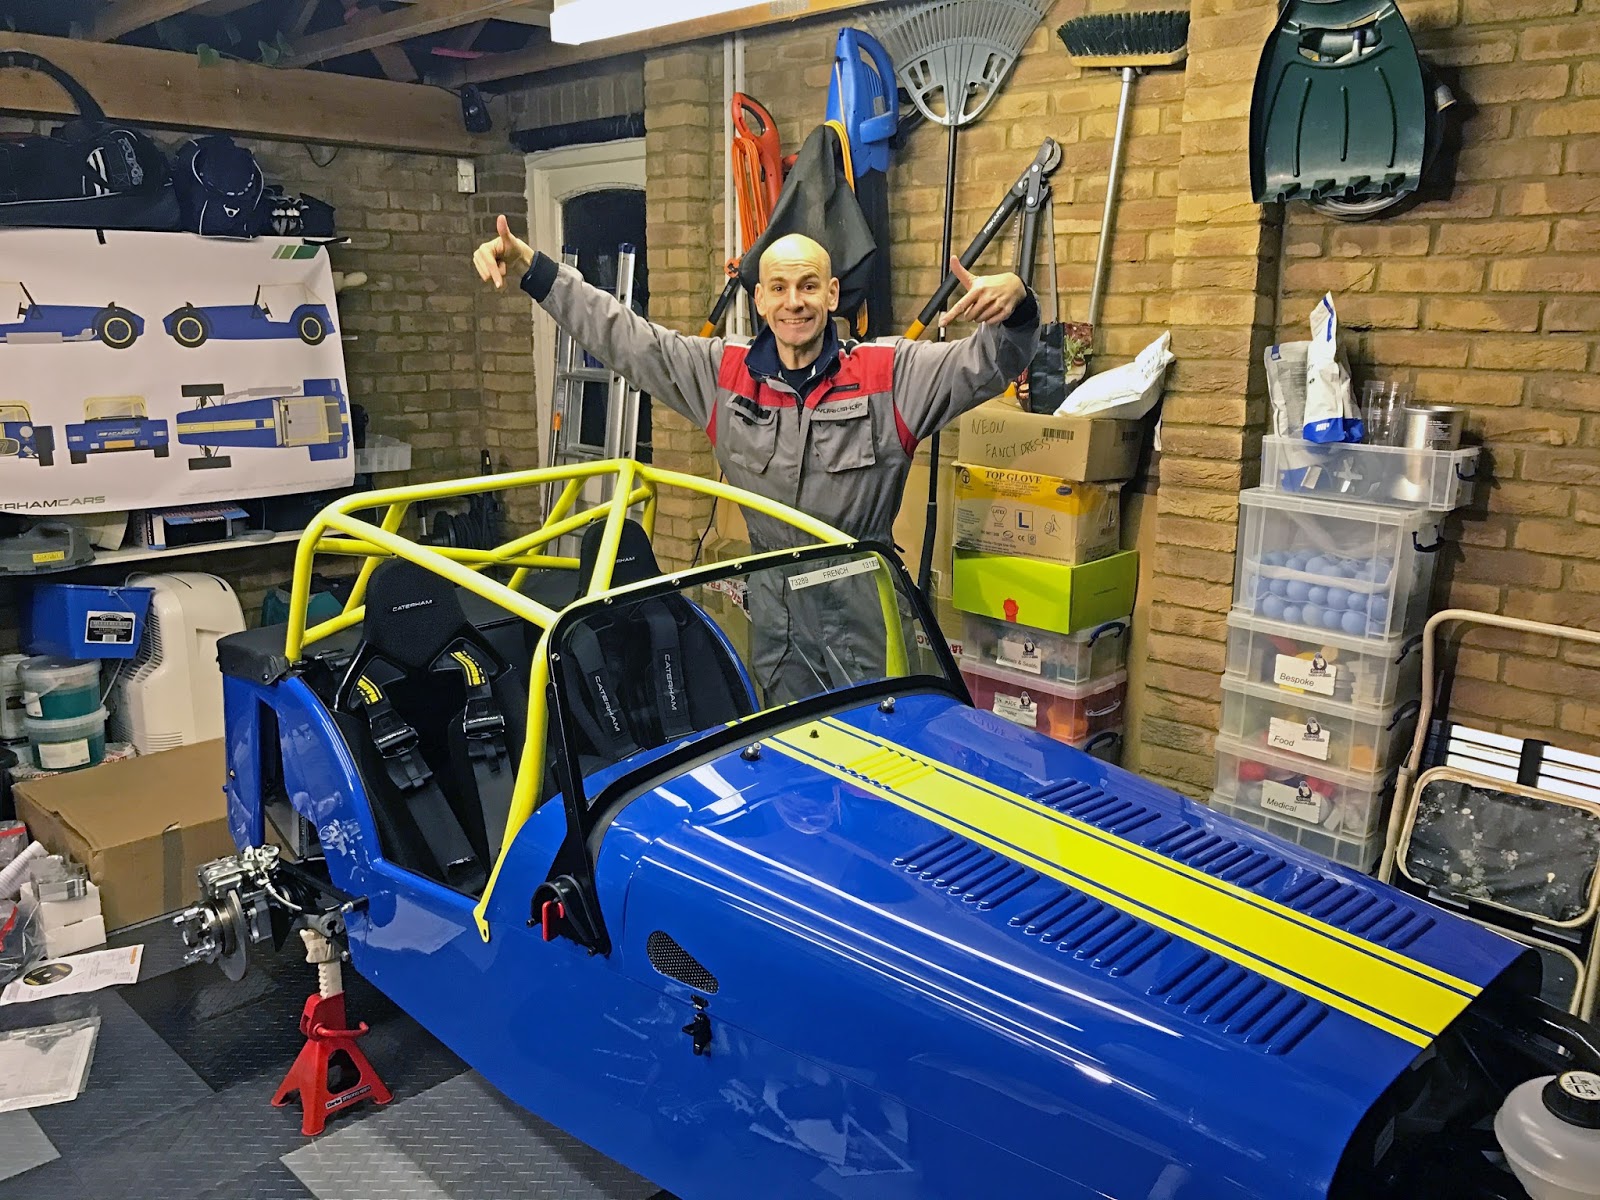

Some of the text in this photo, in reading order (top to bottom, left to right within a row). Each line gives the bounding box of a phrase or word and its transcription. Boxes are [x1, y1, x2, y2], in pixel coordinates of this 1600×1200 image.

[972, 419, 1005, 434] NEON
[986, 439, 1051, 458] FANCY DRESS
[985, 470, 1042, 484] TOP GLOVE
[1018, 512, 1029, 528] L
[822, 566, 849, 579] FRENCH
[392, 600, 432, 612] CATERHAM
[664, 654, 678, 711] CATERHAM
[1280, 672, 1314, 686] Bespoke
[595, 675, 620, 732] CATERHAM
[378, 730, 407, 743] CATERHAM
[1274, 736, 1295, 747] Food
[1267, 798, 1298, 812] Medical
